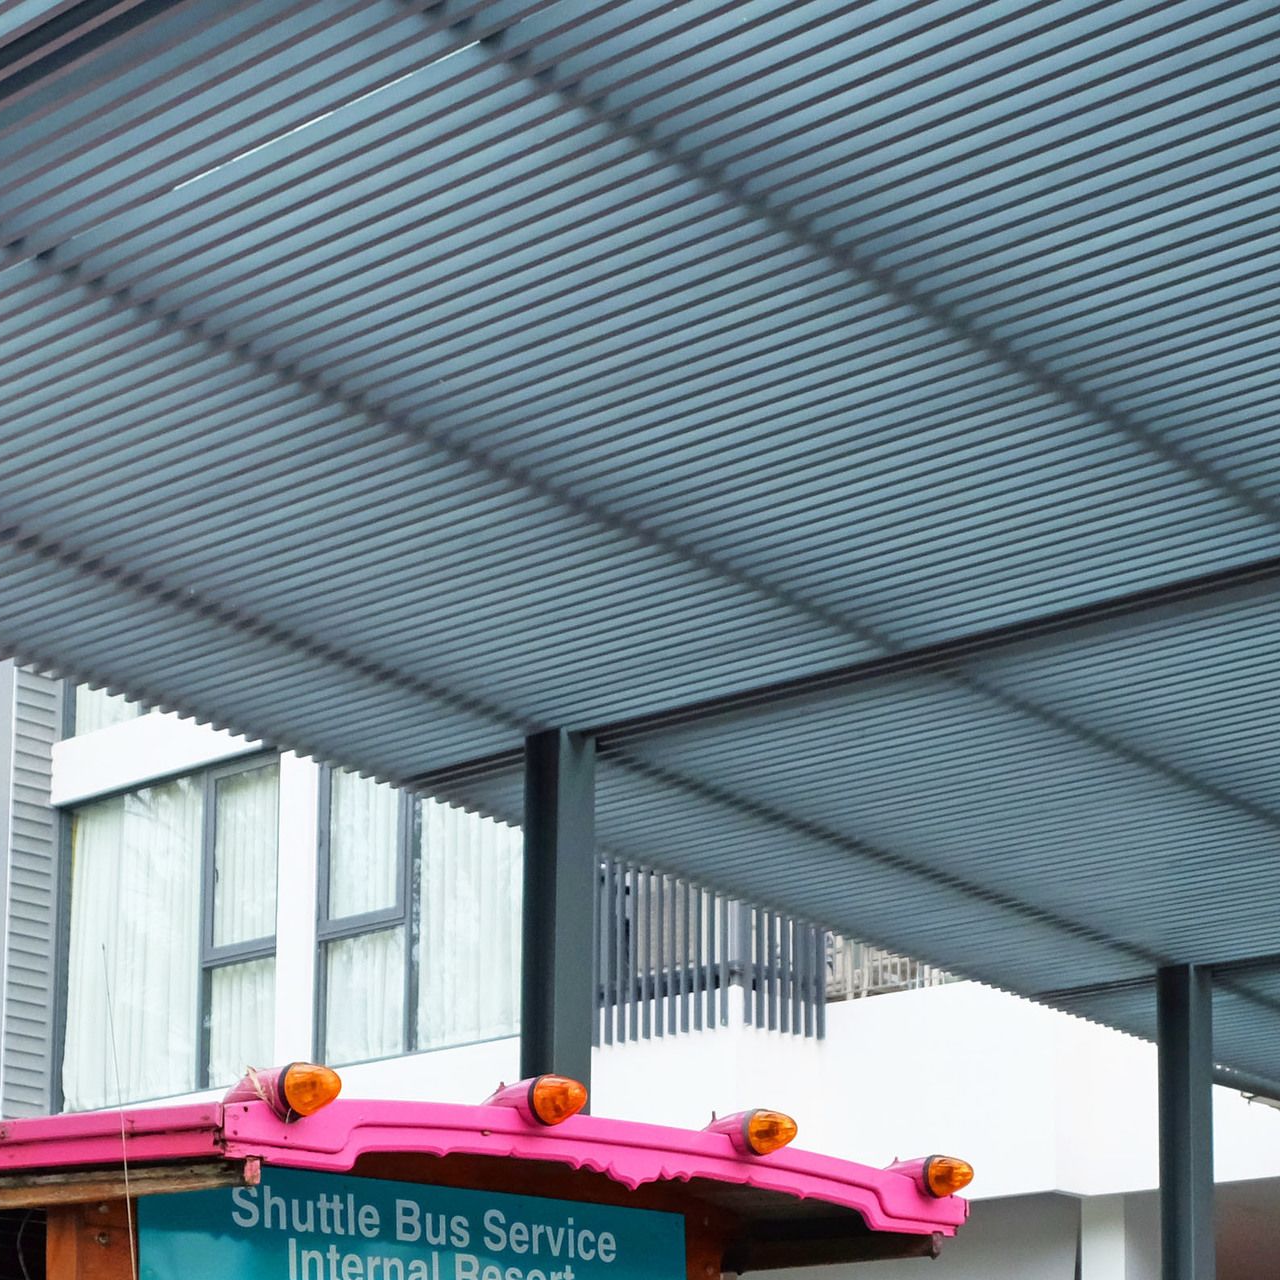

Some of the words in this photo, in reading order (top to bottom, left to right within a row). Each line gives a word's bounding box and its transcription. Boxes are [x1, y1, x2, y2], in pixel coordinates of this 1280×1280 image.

[231, 1184, 380, 1239] Shuttle
[395, 1200, 471, 1248] Bus
[483, 1209, 617, 1264] Service
